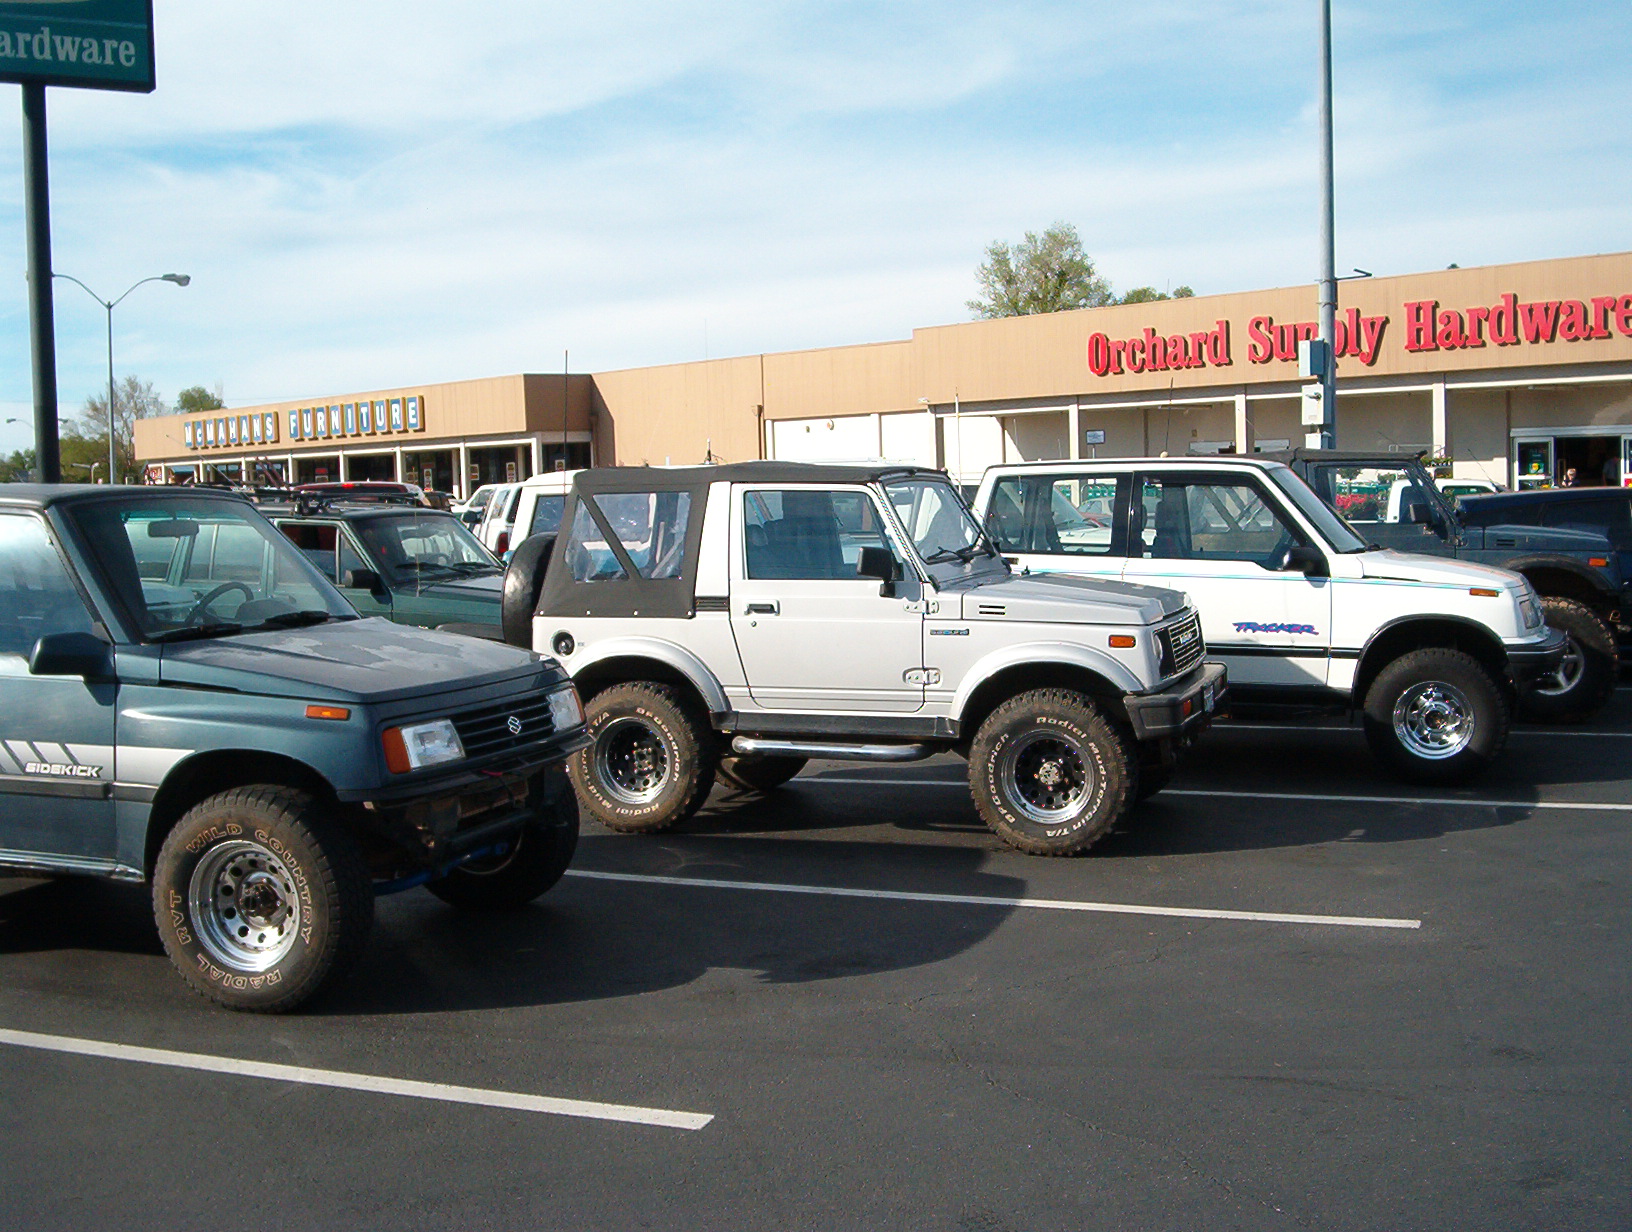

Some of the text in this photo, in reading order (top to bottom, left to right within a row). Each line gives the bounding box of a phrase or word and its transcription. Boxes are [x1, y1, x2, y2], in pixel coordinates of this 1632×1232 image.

[1088, 320, 1230, 376] Orchard
[1403, 293, 1632, 351] Hardware
[289, 401, 418, 438] FURNITURE
[1036, 716, 1087, 739] Radial
[25, 762, 102, 778] SIDEKICK
[186, 822, 313, 945] WILD COUNTRY
[197, 952, 282, 990] RADIAL
